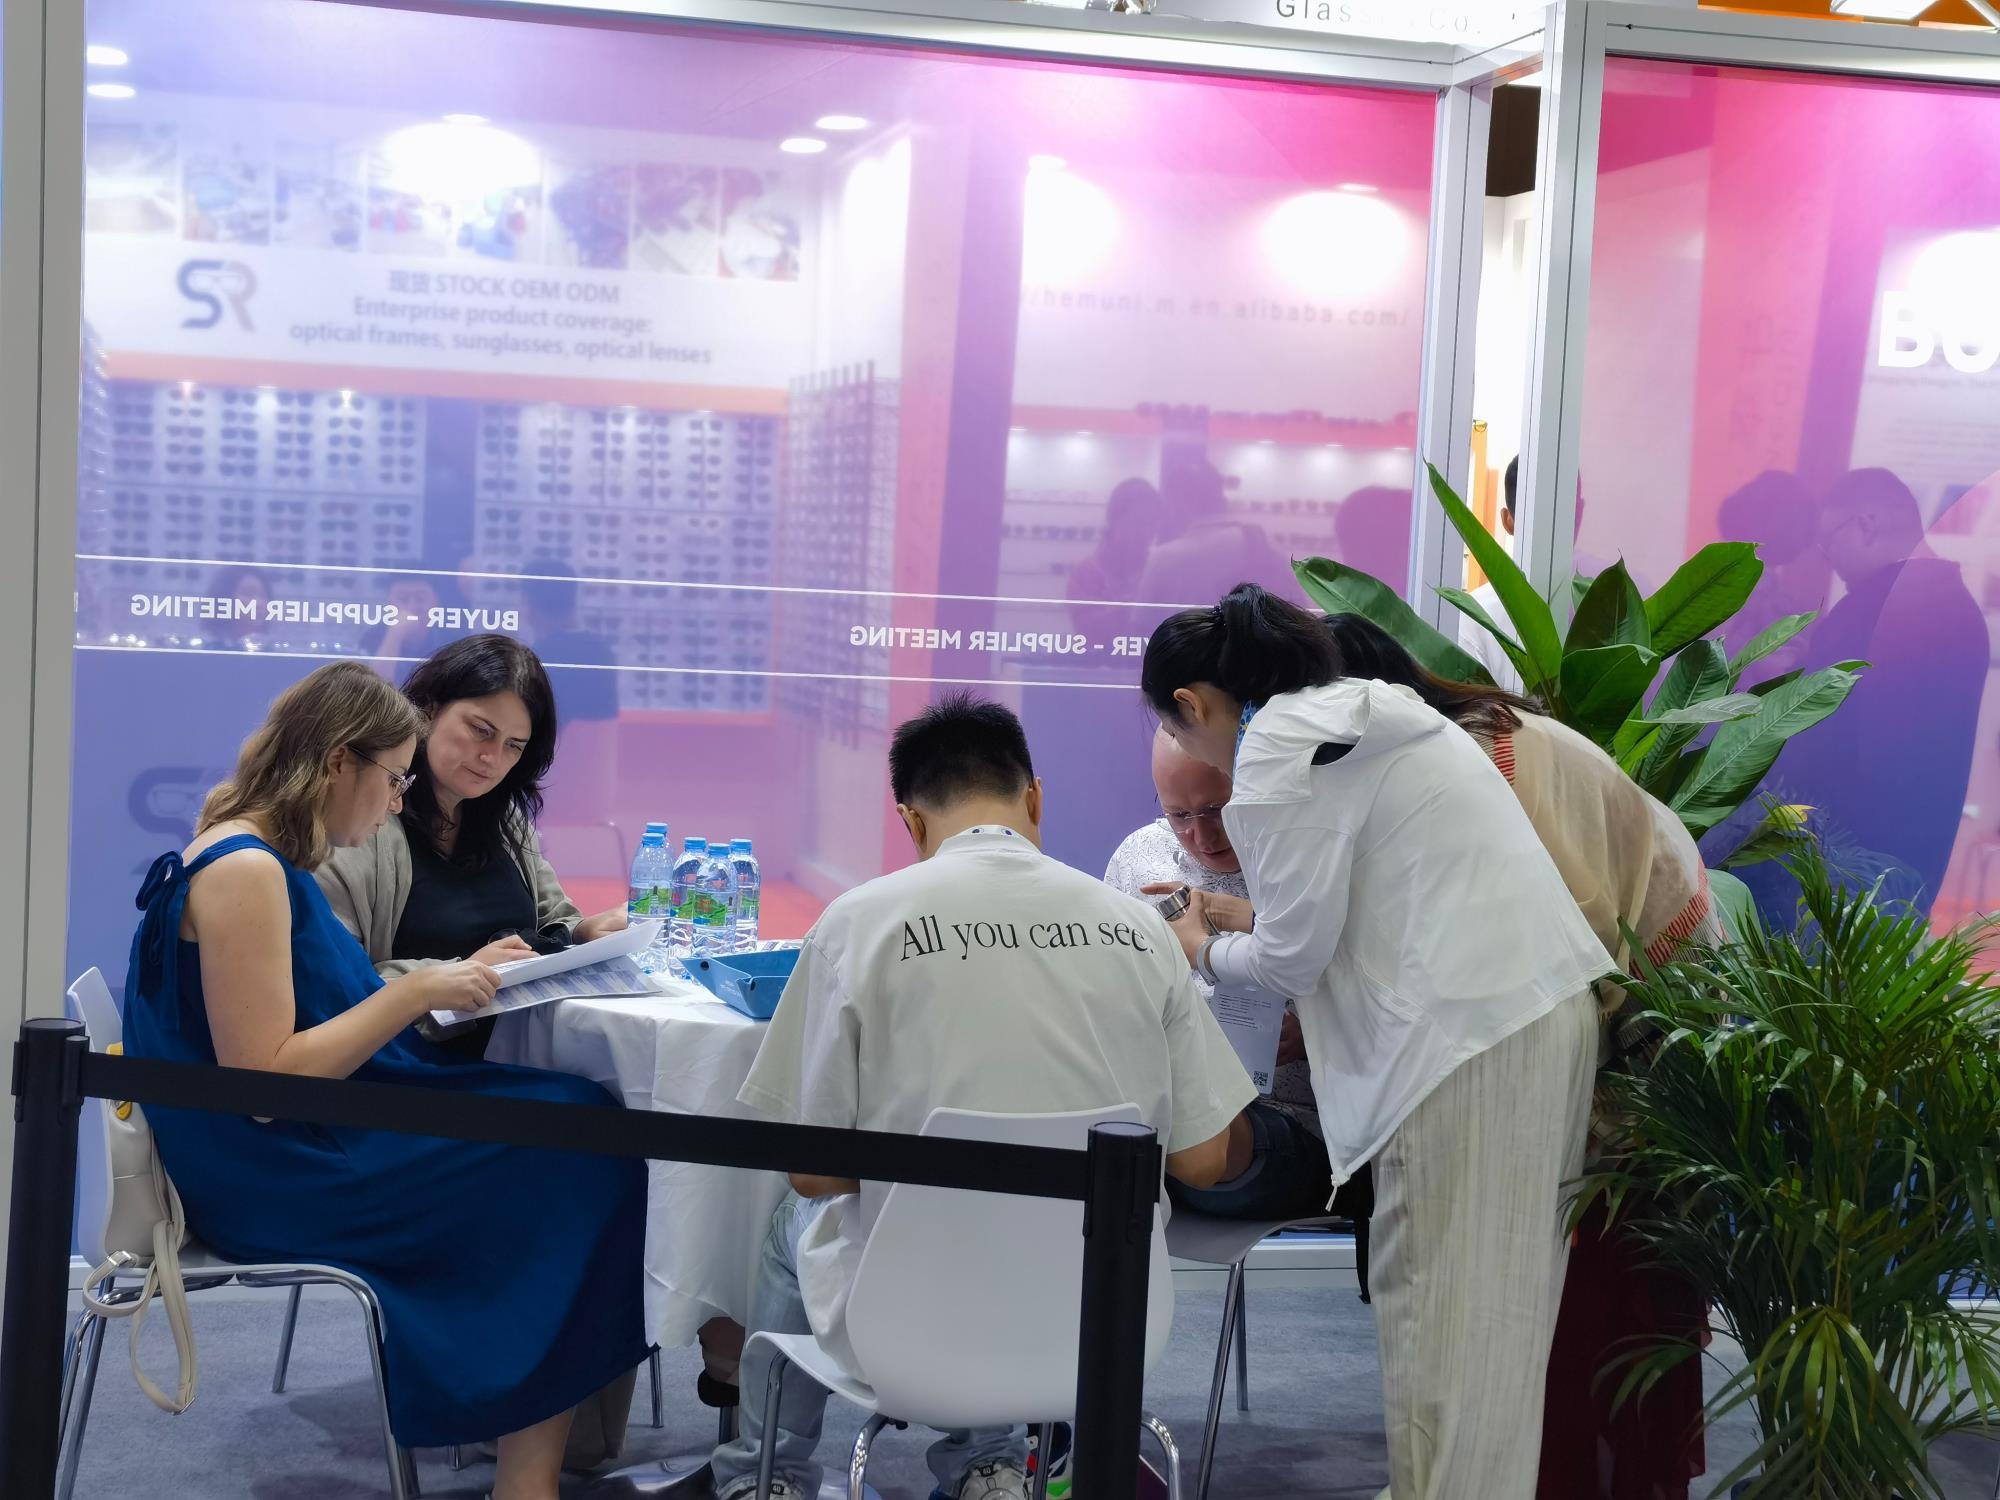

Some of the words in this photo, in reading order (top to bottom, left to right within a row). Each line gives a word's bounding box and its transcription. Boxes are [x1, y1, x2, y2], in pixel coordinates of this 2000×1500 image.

[178, 259, 257, 333] SR
[434, 273, 505, 298] STOCK
[510, 278, 560, 300] OEM
[566, 282, 620, 304] ODM
[354, 297, 460, 324] Enterprise
[466, 301, 549, 329] product
[554, 312, 653, 335] coverage:
[290, 322, 362, 345] optical
[367, 326, 446, 350] frames,
[452, 333, 570, 357] sunglasses,
[574, 340, 644, 361] optical
[650, 344, 712, 364] lenses
[900, 915, 946, 961] All
[952, 921, 1020, 960] you
[1029, 922, 1091, 949] can
[1098, 921, 1154, 954] see.
